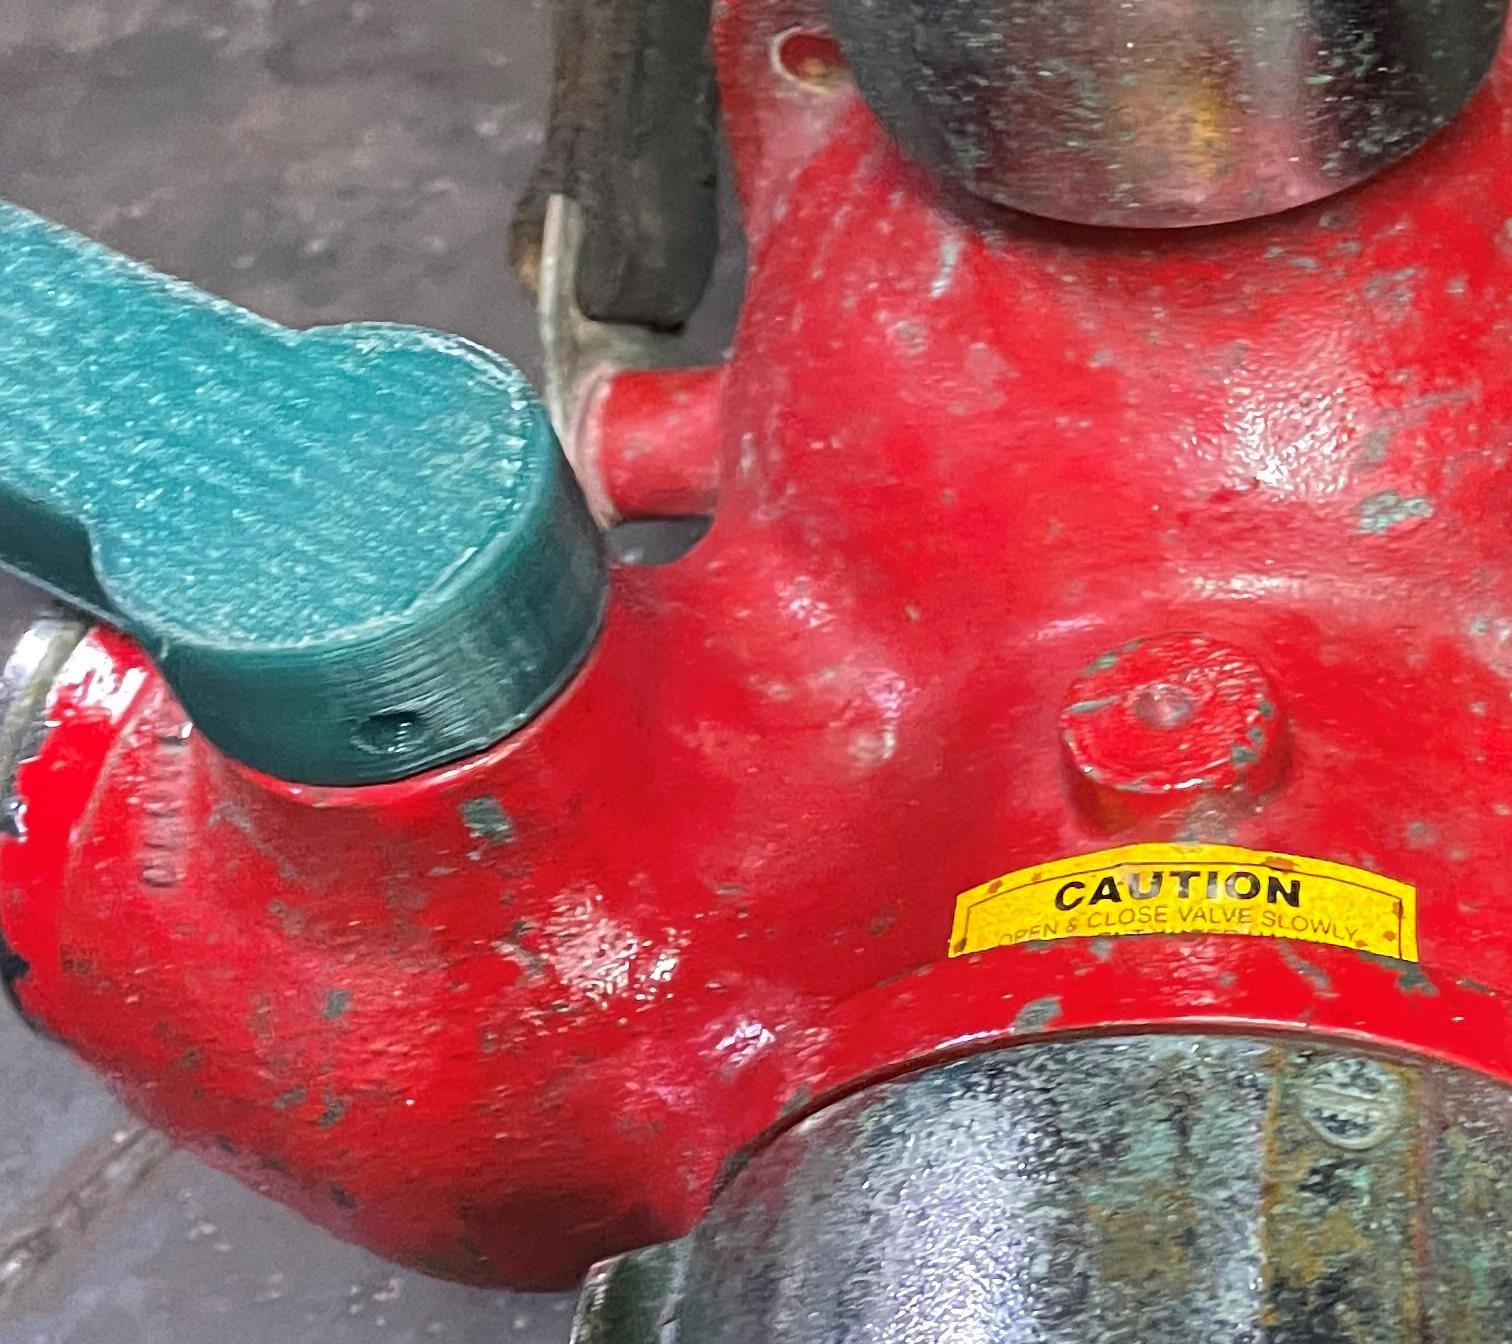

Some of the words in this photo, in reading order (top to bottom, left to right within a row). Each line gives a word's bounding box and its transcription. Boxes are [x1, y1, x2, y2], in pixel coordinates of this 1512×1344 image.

[1054, 870, 1301, 911] CAUTION
[1065, 916, 1078, 933] &
[1087, 905, 1169, 929] CLOSE
[1177, 905, 1252, 924] VALVE
[1260, 910, 1359, 941] SLOWLY
